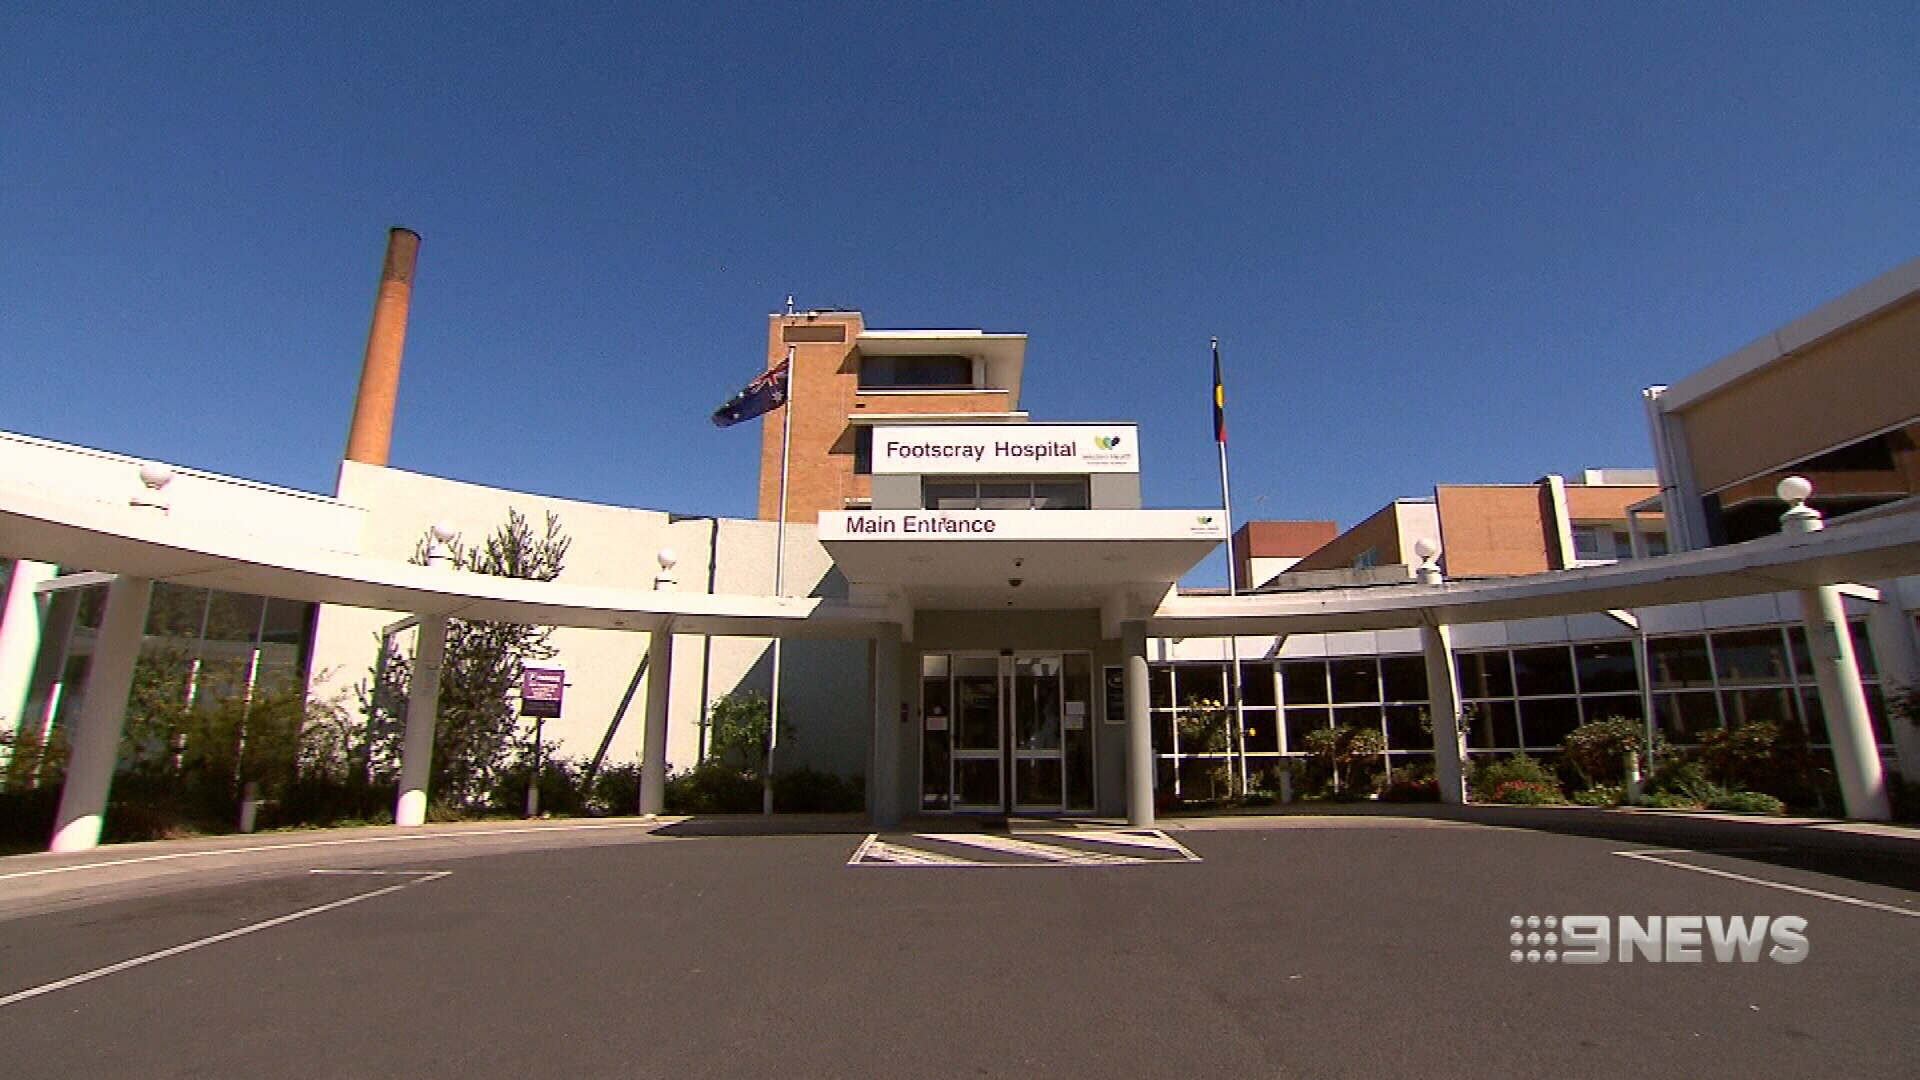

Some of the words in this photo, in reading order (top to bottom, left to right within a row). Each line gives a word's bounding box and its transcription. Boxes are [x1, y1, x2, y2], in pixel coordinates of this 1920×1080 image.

[886, 441, 985, 462] Footscray
[994, 441, 1077, 461] Hospital
[846, 515, 896, 533] Main
[903, 515, 996, 533] Entrance
